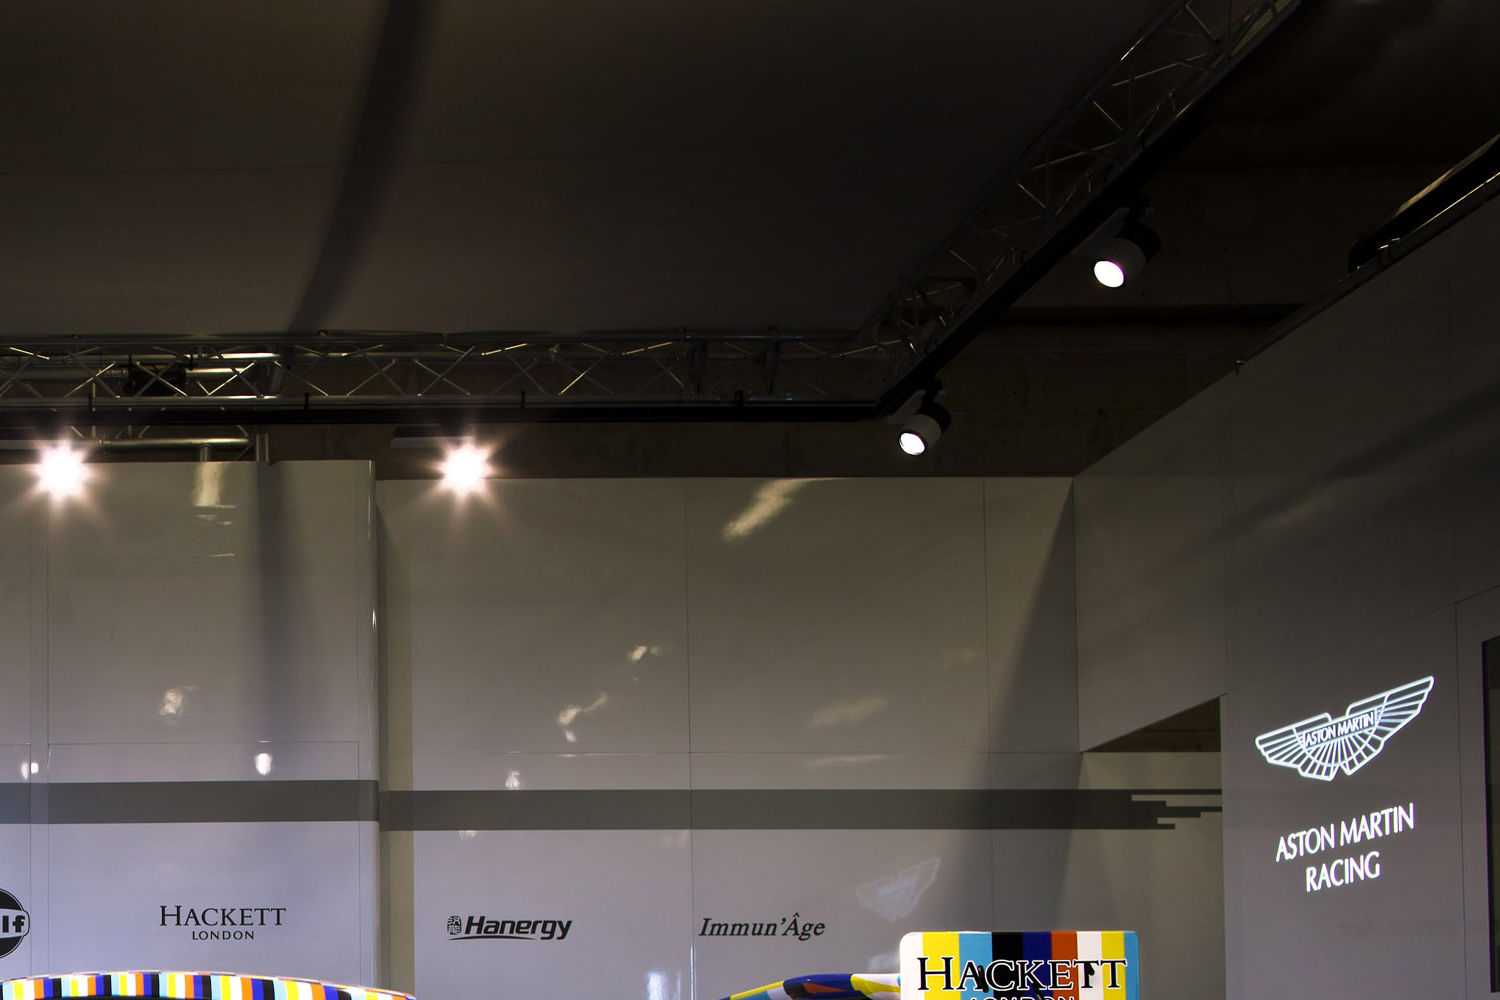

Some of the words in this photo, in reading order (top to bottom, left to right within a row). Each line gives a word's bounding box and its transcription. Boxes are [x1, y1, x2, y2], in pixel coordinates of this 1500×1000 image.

[1306, 724, 1336, 747] ASTON
[1338, 711, 1374, 737] MARTIN
[1275, 823, 1336, 862] ASTON
[1339, 802, 1415, 847] MARTIN
[1305, 850, 1381, 893] RACING
[160, 905, 287, 926] HACKETT
[464, 915, 573, 940] Hanergy
[192, 930, 254, 940] LONDON
[916, 957, 1127, 991] HACKETT
